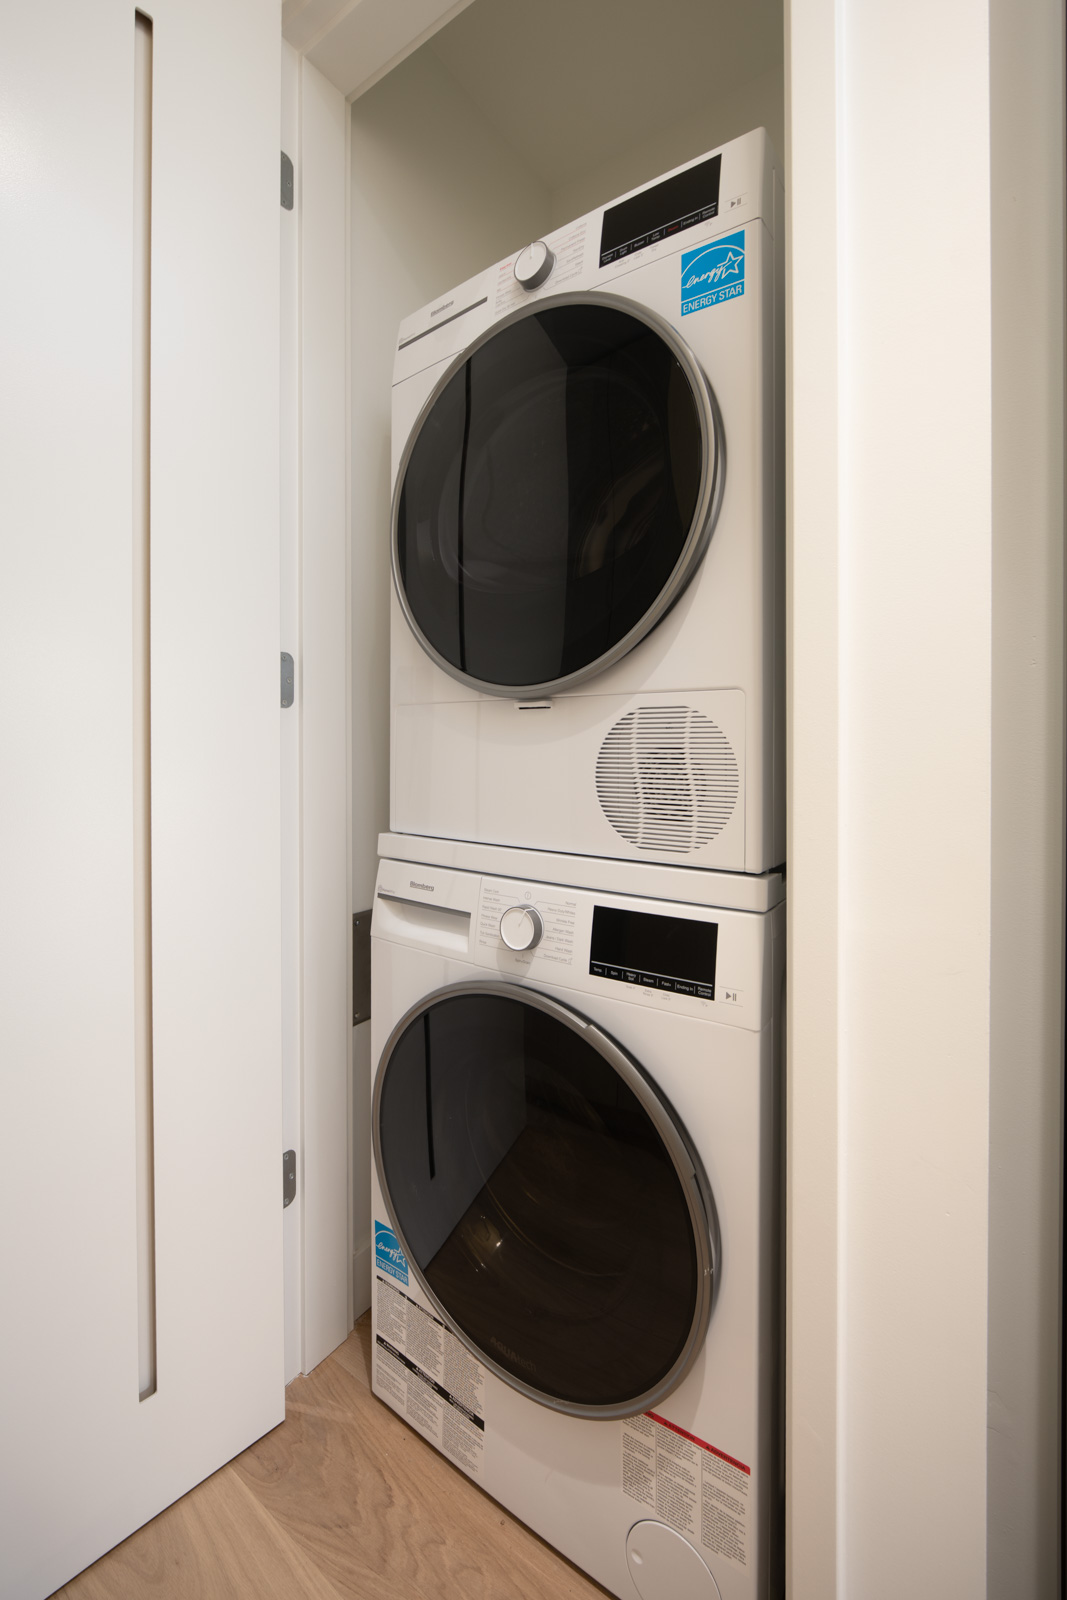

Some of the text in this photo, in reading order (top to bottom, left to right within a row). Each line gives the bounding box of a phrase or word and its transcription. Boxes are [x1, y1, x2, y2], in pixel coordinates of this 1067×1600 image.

[682, 264, 726, 289] energy
[683, 284, 743, 314] ENERGY STAR
[410, 880, 434, 892] Blomberg
[376, 1258, 408, 1284] ENERGY STAR
